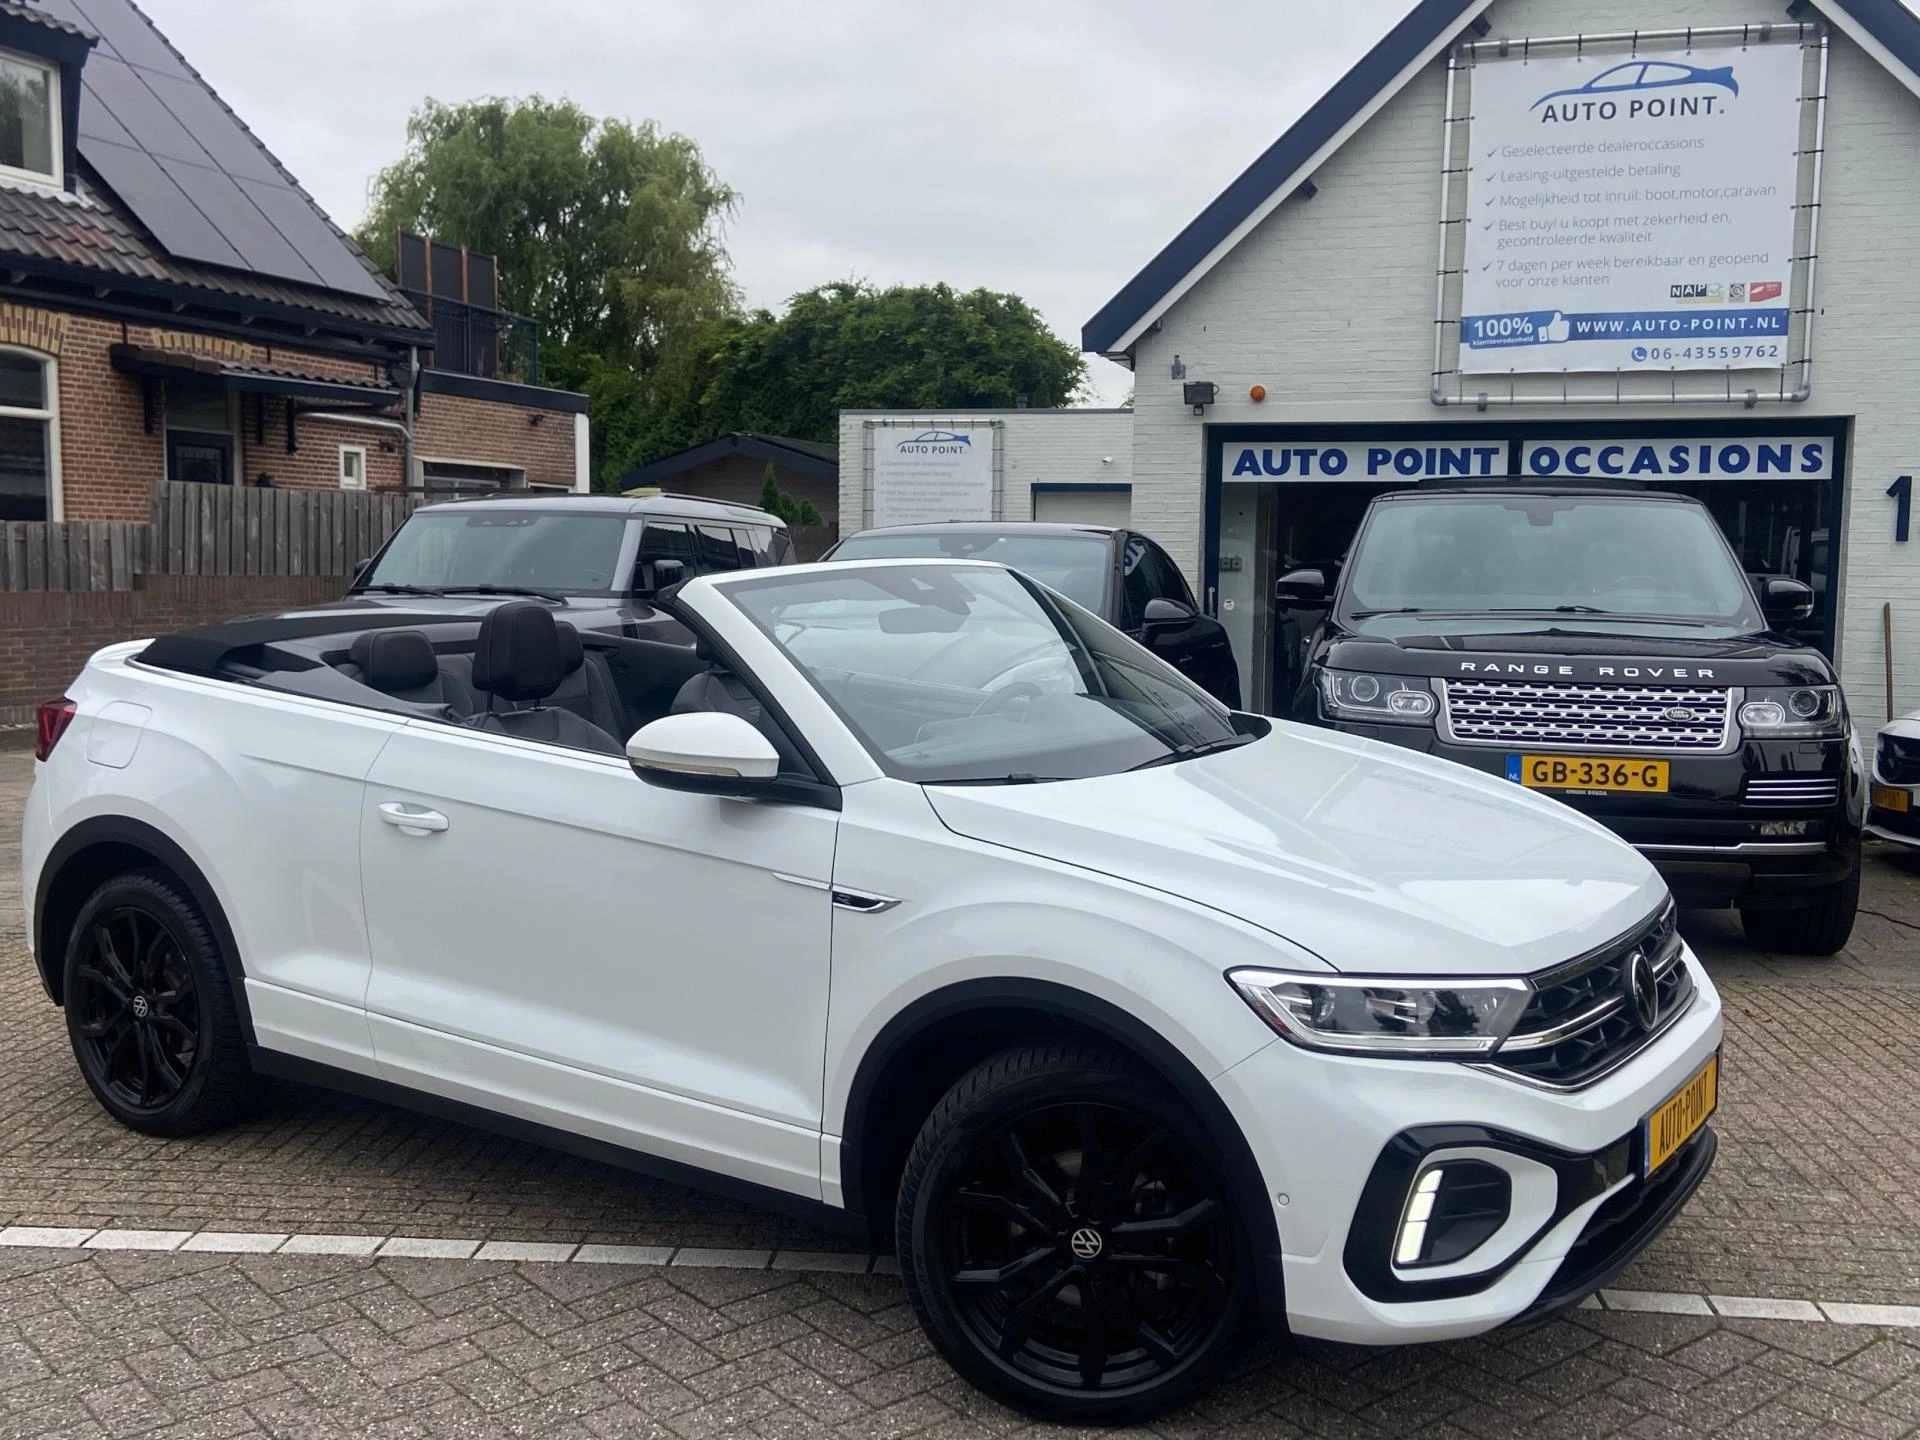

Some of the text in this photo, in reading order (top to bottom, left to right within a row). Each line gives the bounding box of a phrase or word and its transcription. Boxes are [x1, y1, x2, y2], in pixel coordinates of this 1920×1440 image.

[1541, 101, 1617, 123] AUTO
[1501, 136, 1705, 158] Geselecteerde dealeroccasions
[1500, 162, 1681, 183] Leasing-uitgestelde betaling
[1500, 192, 1580, 209] Mogelijkheid
[1583, 192, 1602, 203] tot
[1605, 188, 1642, 202] inruil:
[1499, 219, 1526, 231] Best
[1560, 218, 1568, 229] u
[1573, 216, 1609, 230] koopt
[1614, 215, 1639, 226] met
[1642, 211, 1708, 226] zekerheid
[1497, 230, 1653, 251] gecontroleerde kwaliteit
[1496, 251, 1769, 274] 7 dagen per week bereikbaar en geopend
[1495, 274, 1610, 289] voor onze klanten
[1671, 284, 1706, 298] NAP
[1474, 316, 1533, 338] 100%
[1576, 316, 1781, 333] WWW.AUTO-POINT.NL
[1650, 345, 1779, 360] 06-43559762
[900, 445, 928, 454] AUTO
[1529, 443, 1823, 475] OCCASIONS
[1231, 447, 1500, 476] AUTO POINT
[1885, 475, 1912, 542] 1
[1460, 662, 1715, 679] RANGE ROVER
[1508, 773, 1519, 781] NL
[1532, 760, 1658, 788] GB-336-G
[1659, 1071, 1708, 1157] AUTO-POINT
